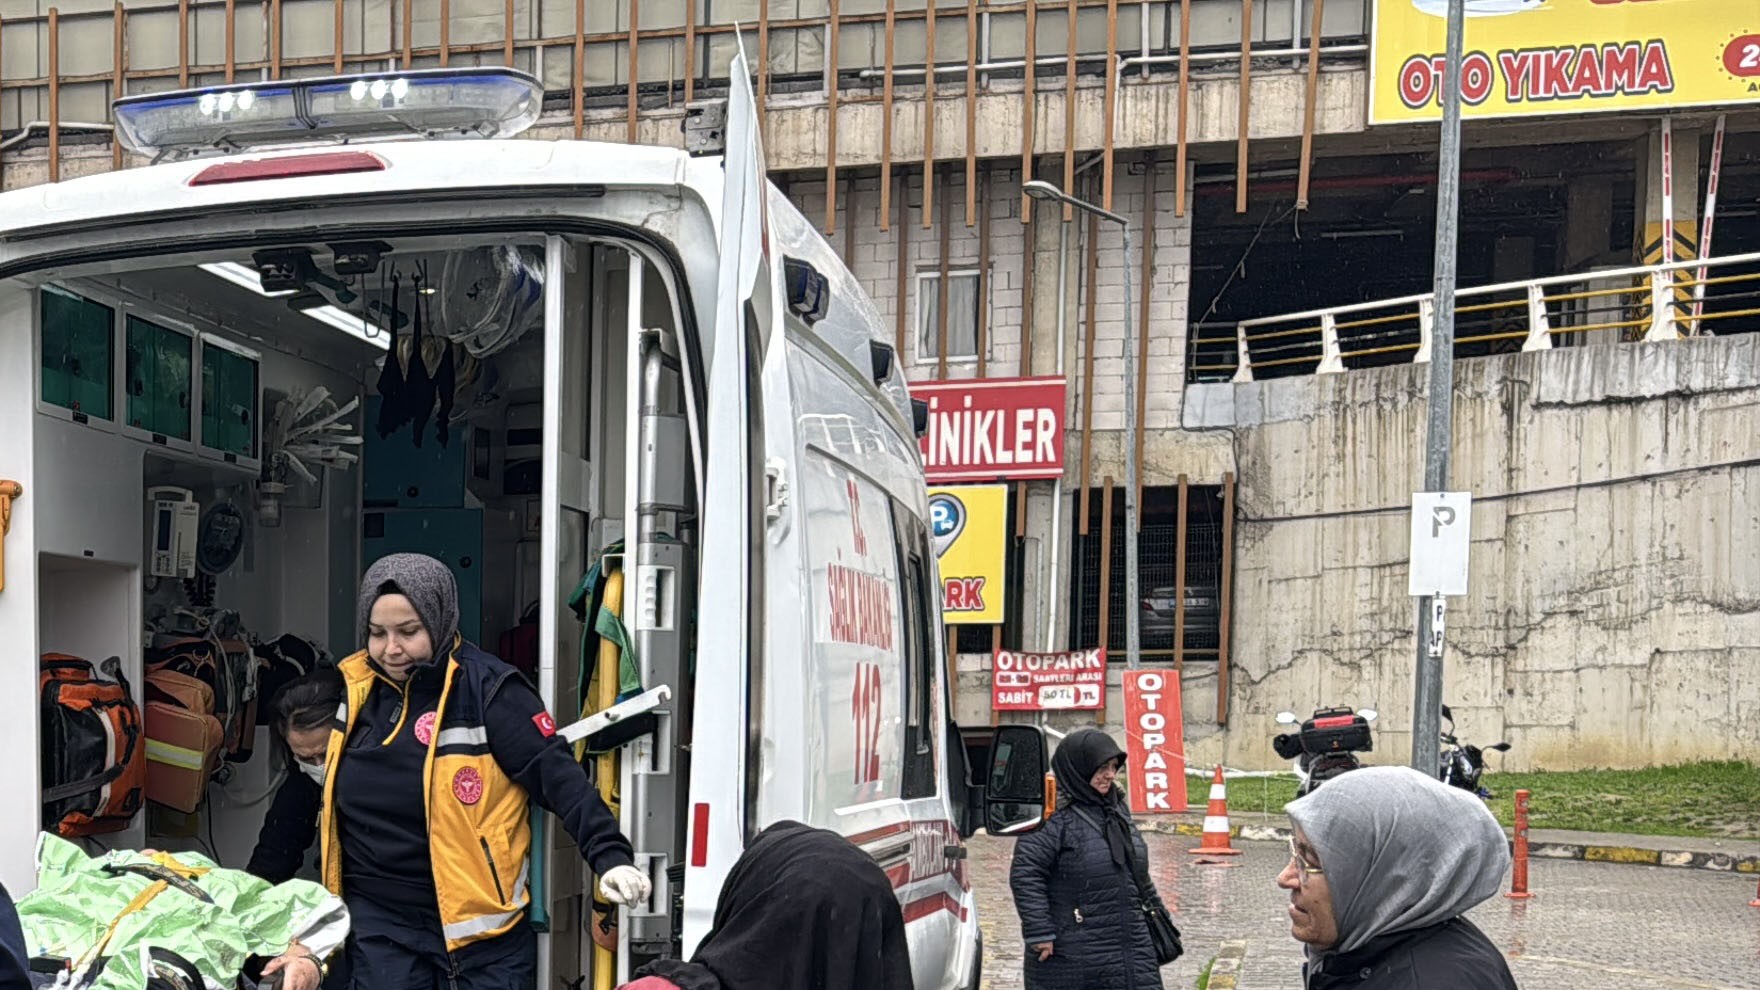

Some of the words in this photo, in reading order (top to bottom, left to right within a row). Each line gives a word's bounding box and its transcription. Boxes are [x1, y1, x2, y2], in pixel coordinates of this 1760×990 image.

[1498, 40, 1673, 101] YIKAMA
[1739, 43, 1760, 68] 2
[1432, 506, 1456, 538] P
[943, 577, 984, 610] RK
[997, 649, 1102, 671] OTOPARK
[998, 689, 1034, 704] SABİT
[852, 661, 881, 784] 112
[1137, 673, 1171, 810] OTOPARK
